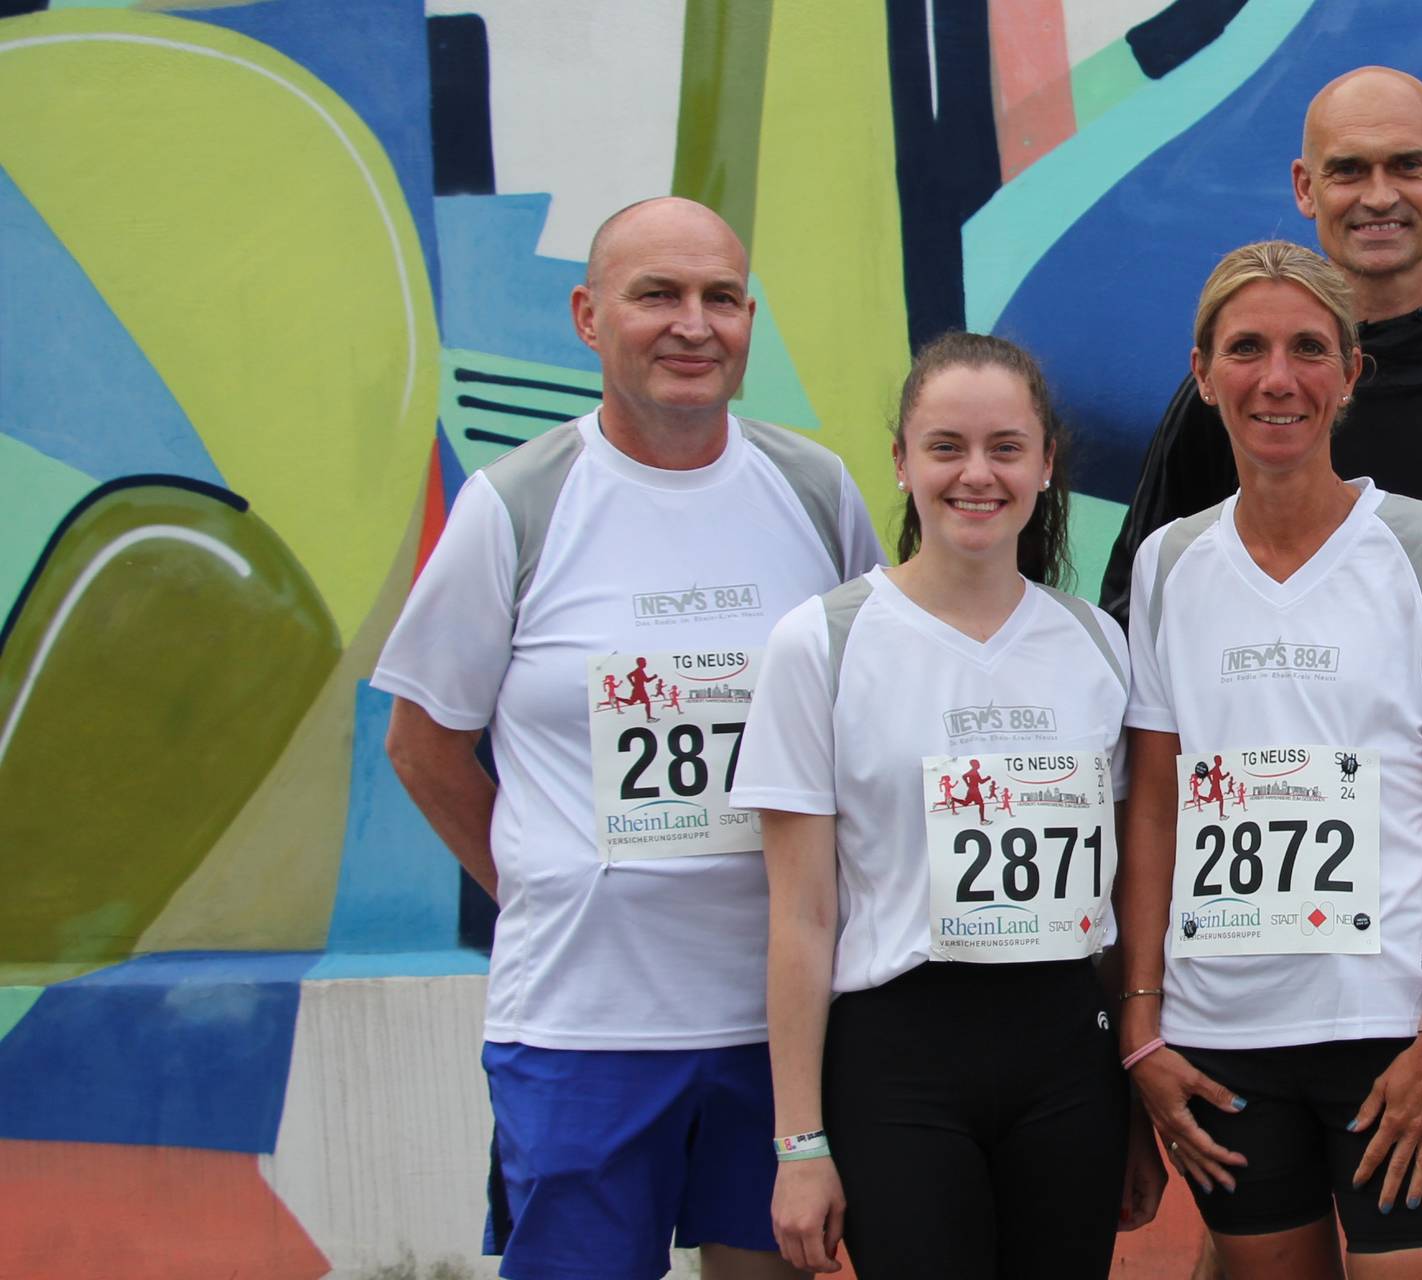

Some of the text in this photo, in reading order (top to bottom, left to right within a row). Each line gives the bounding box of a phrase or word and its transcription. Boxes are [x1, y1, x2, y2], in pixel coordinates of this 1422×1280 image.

[714, 588, 754, 609] 89.4
[673, 652, 745, 669] TG NEUSS
[1293, 647, 1331, 669] 89.4
[1009, 709, 1050, 730] 89.4
[618, 722, 747, 800] 287
[1004, 756, 1075, 771] TG NEUSS
[1242, 749, 1306, 766] TG NEUSS
[1341, 786, 1355, 800] 24
[606, 809, 710, 834] RheinLand
[719, 813, 749, 825] STADT
[608, 832, 710, 845] VERSICHERUNGSGRUPPE
[954, 826, 1102, 902] 2871
[1193, 819, 1355, 897] 2872
[941, 914, 1039, 936] RheinLand
[1049, 920, 1073, 932] STADT
[1270, 914, 1299, 926] STADT
[940, 937, 1039, 947] VERSICHERUNGSGRUPPE
